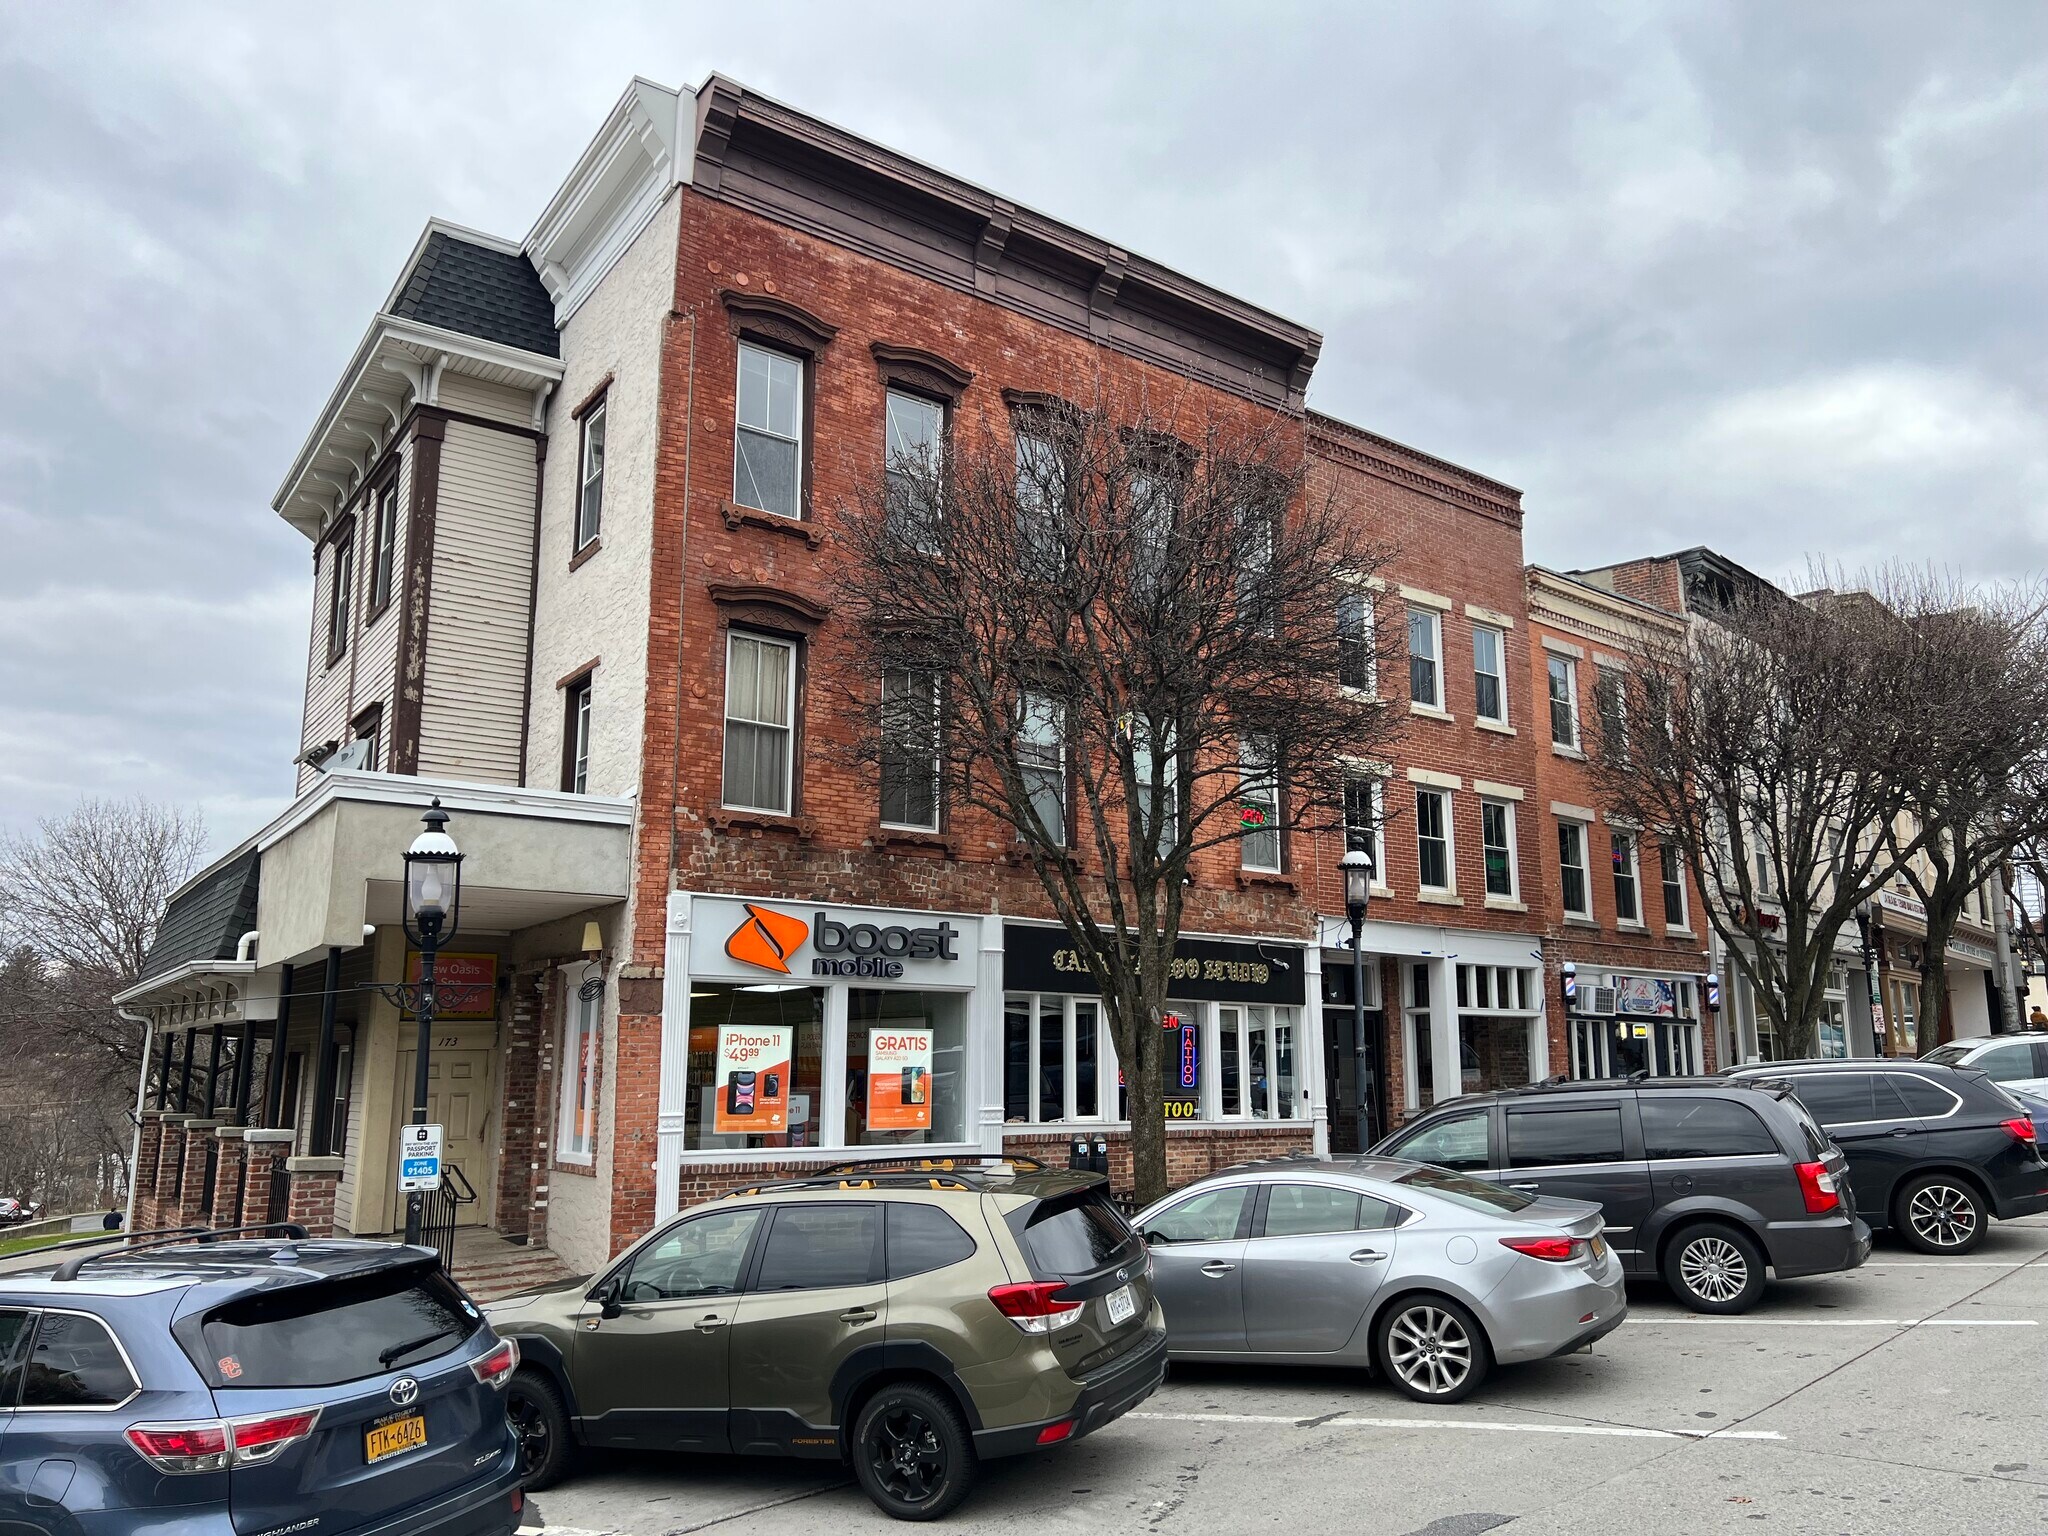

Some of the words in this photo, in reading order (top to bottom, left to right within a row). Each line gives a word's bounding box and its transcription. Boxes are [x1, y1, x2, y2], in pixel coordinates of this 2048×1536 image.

[813, 912, 959, 961] boost
[450, 964, 480, 975] Oasis
[812, 956, 904, 978] mobile
[1203, 959, 1270, 984] STUDIO
[1163, 1014, 1178, 1028] EN
[438, 1037, 458, 1047] 173
[726, 1033, 771, 1047] iPhone
[772, 1034, 781, 1047] 11
[875, 1036, 927, 1051] GRATIS
[1183, 1028, 1193, 1083] TATTOO
[1163, 1101, 1194, 1118] TOO
[407, 1166, 433, 1175] 91405
